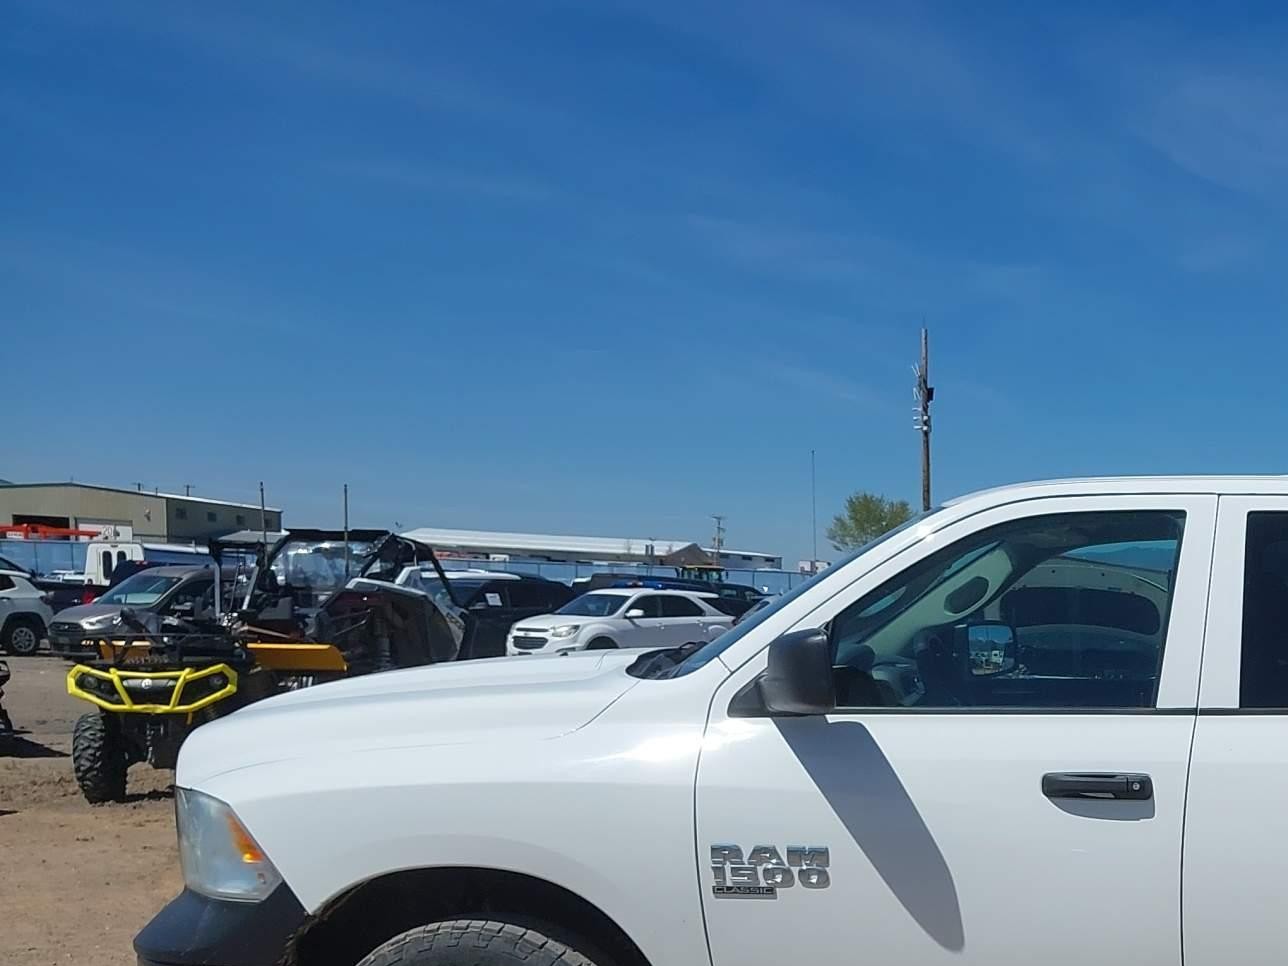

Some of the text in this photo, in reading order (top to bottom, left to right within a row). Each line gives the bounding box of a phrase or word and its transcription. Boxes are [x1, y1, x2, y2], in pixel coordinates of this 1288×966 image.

[711, 845, 829, 868] RAM
[711, 865, 831, 889] 1500
[714, 886, 774, 894] CLASSIC
